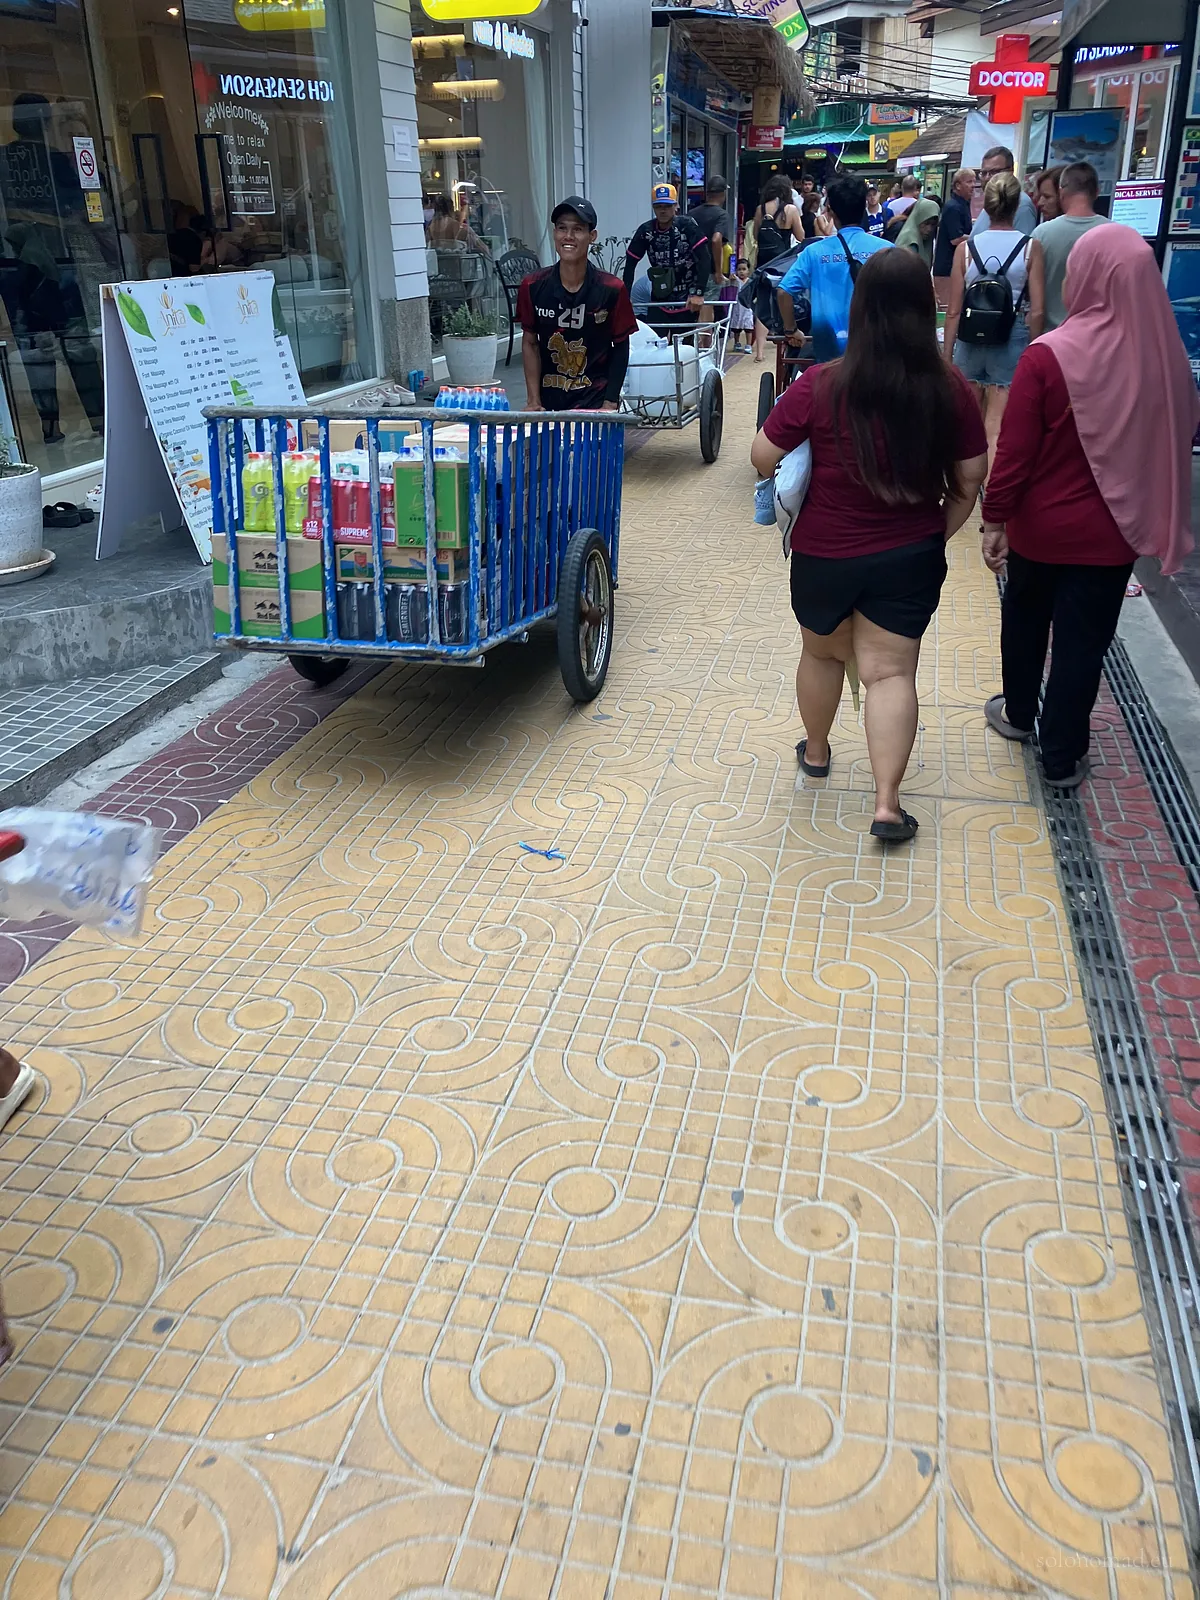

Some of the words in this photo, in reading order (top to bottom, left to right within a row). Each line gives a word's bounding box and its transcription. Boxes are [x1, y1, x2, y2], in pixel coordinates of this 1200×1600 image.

[780, 18, 803, 38] OX
[978, 71, 1045, 87] DOCTOR
[215, 101, 262, 125] Welcome
[236, 134, 245, 146] to
[247, 135, 265, 148] relax
[226, 151, 246, 168] Open
[245, 153, 262, 169] Daily
[1114, 190, 1135, 199] DICAL
[557, 303, 586, 330] 29
[340, 526, 369, 538] SUPREME
